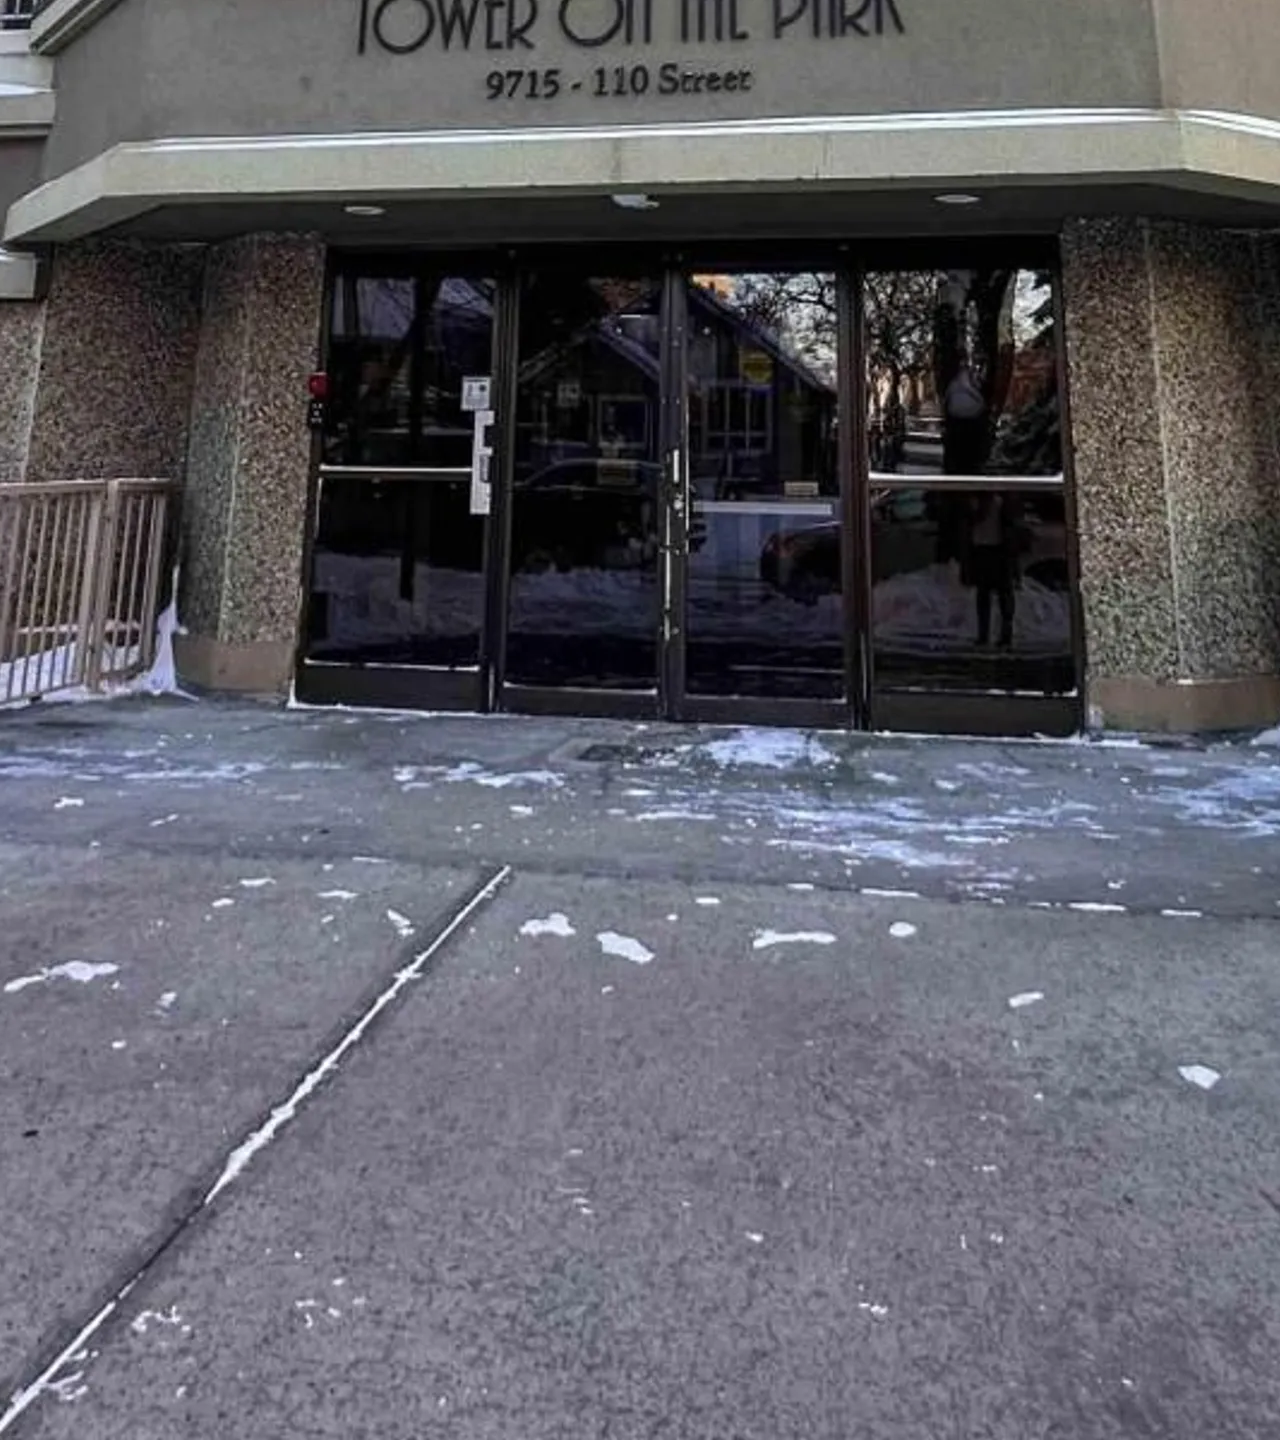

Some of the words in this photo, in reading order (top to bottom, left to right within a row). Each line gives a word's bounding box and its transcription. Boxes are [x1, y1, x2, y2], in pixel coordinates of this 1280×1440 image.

[486, 68, 561, 100] 9715
[593, 64, 650, 97] 110
[658, 62, 752, 95] Street
